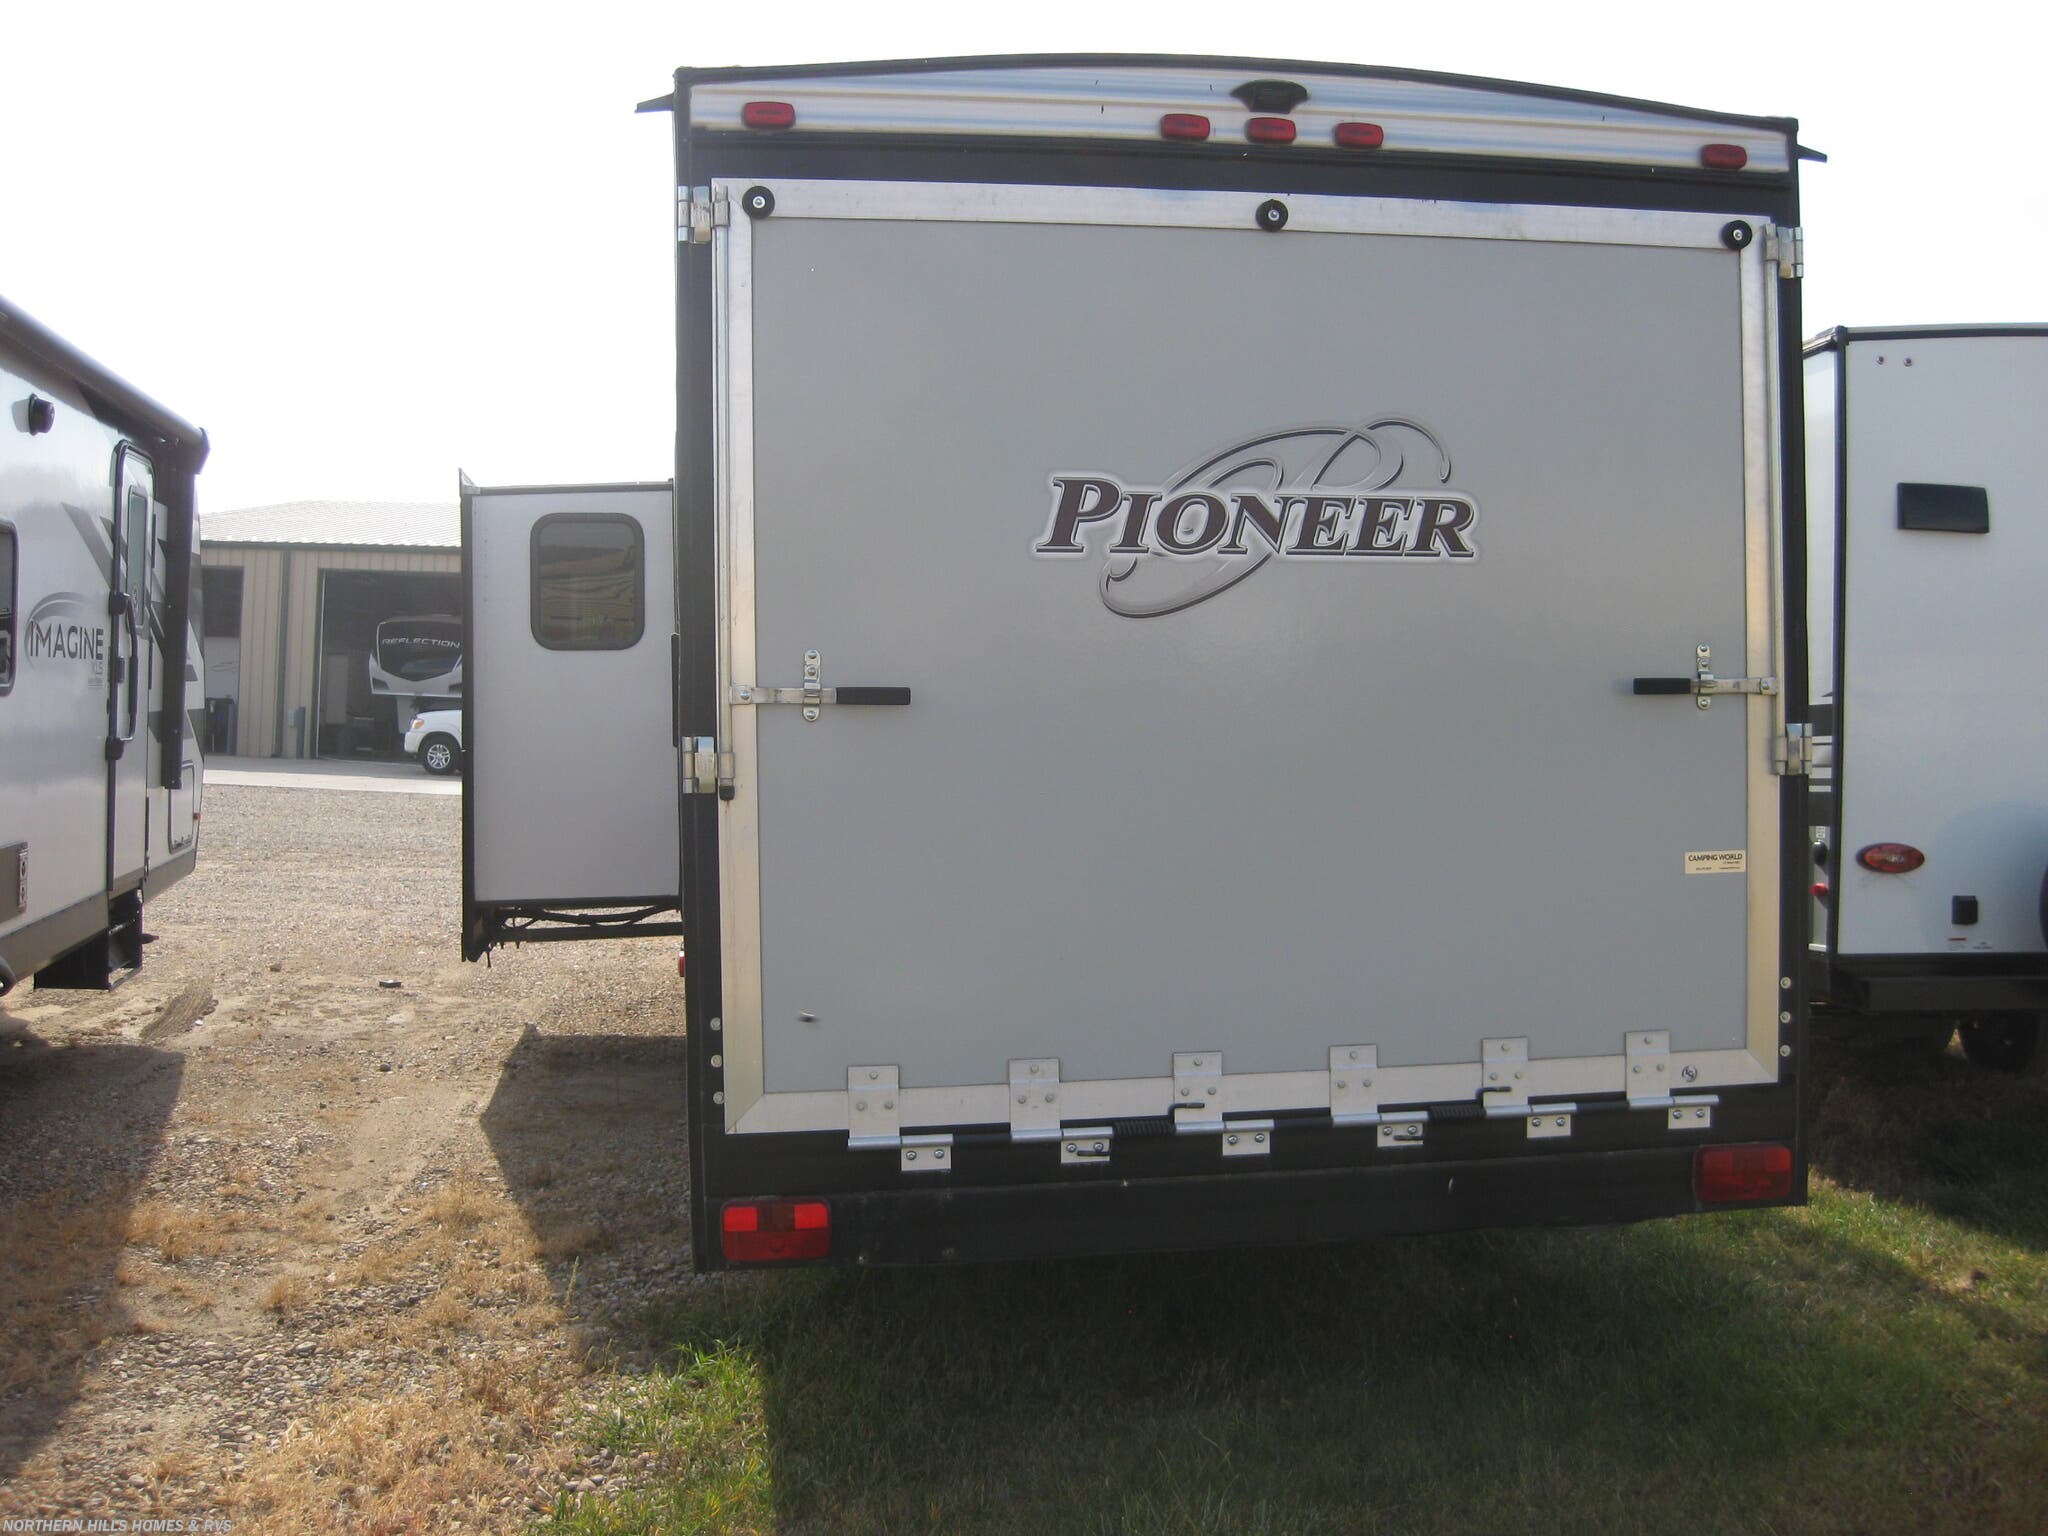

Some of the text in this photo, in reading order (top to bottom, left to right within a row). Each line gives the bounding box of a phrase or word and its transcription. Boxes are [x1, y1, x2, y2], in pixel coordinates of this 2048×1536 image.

[1034, 475, 1477, 558] PIONEER
[29, 620, 104, 661] IMAGINE
[382, 637, 461, 649] REFLECTION
[1688, 853, 1743, 862] CAMPING WORLD
